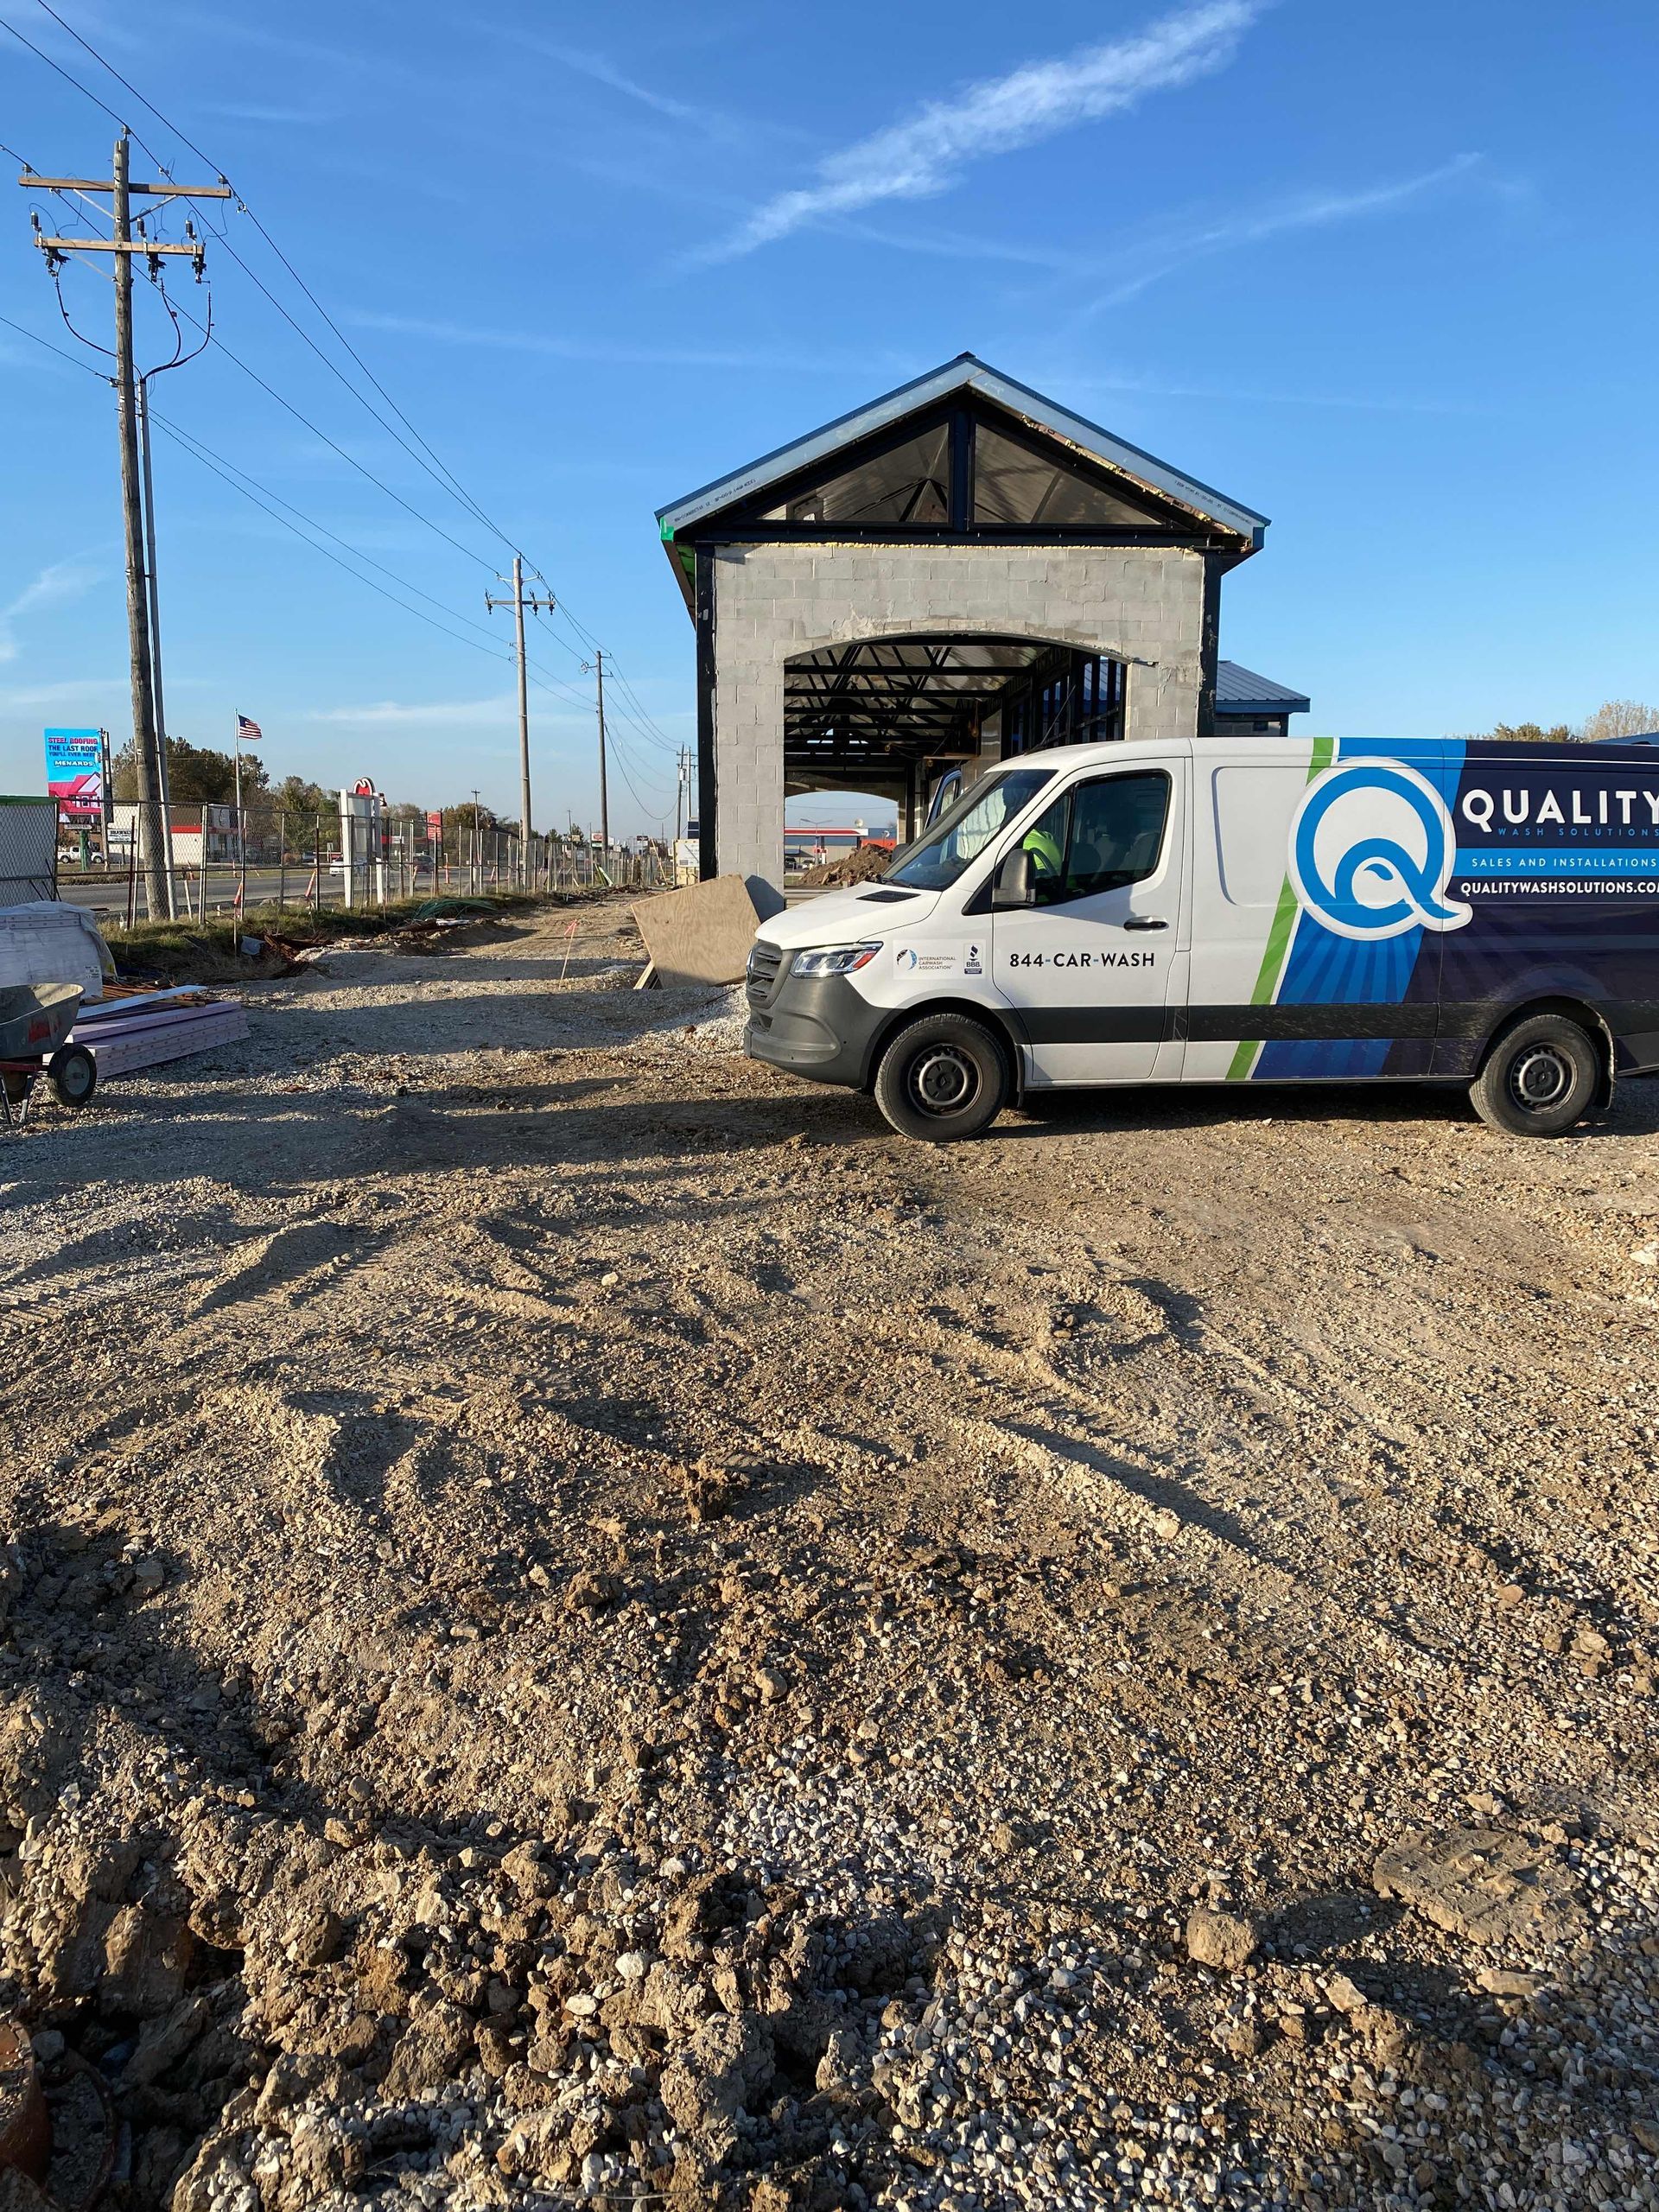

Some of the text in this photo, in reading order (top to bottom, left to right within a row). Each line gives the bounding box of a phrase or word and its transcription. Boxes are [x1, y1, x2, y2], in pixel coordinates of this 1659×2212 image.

[1462, 789, 1659, 833] QUALITY
[1498, 828, 1659, 836] WASH SOLUTIONS
[1471, 858, 1656, 867] SALES AND INSTALLATIONS
[1461, 881, 1659, 896] QUALITYWASHSOLUTIONS.CO
[1009, 953, 1154, 967] 844-CAR-WASH
